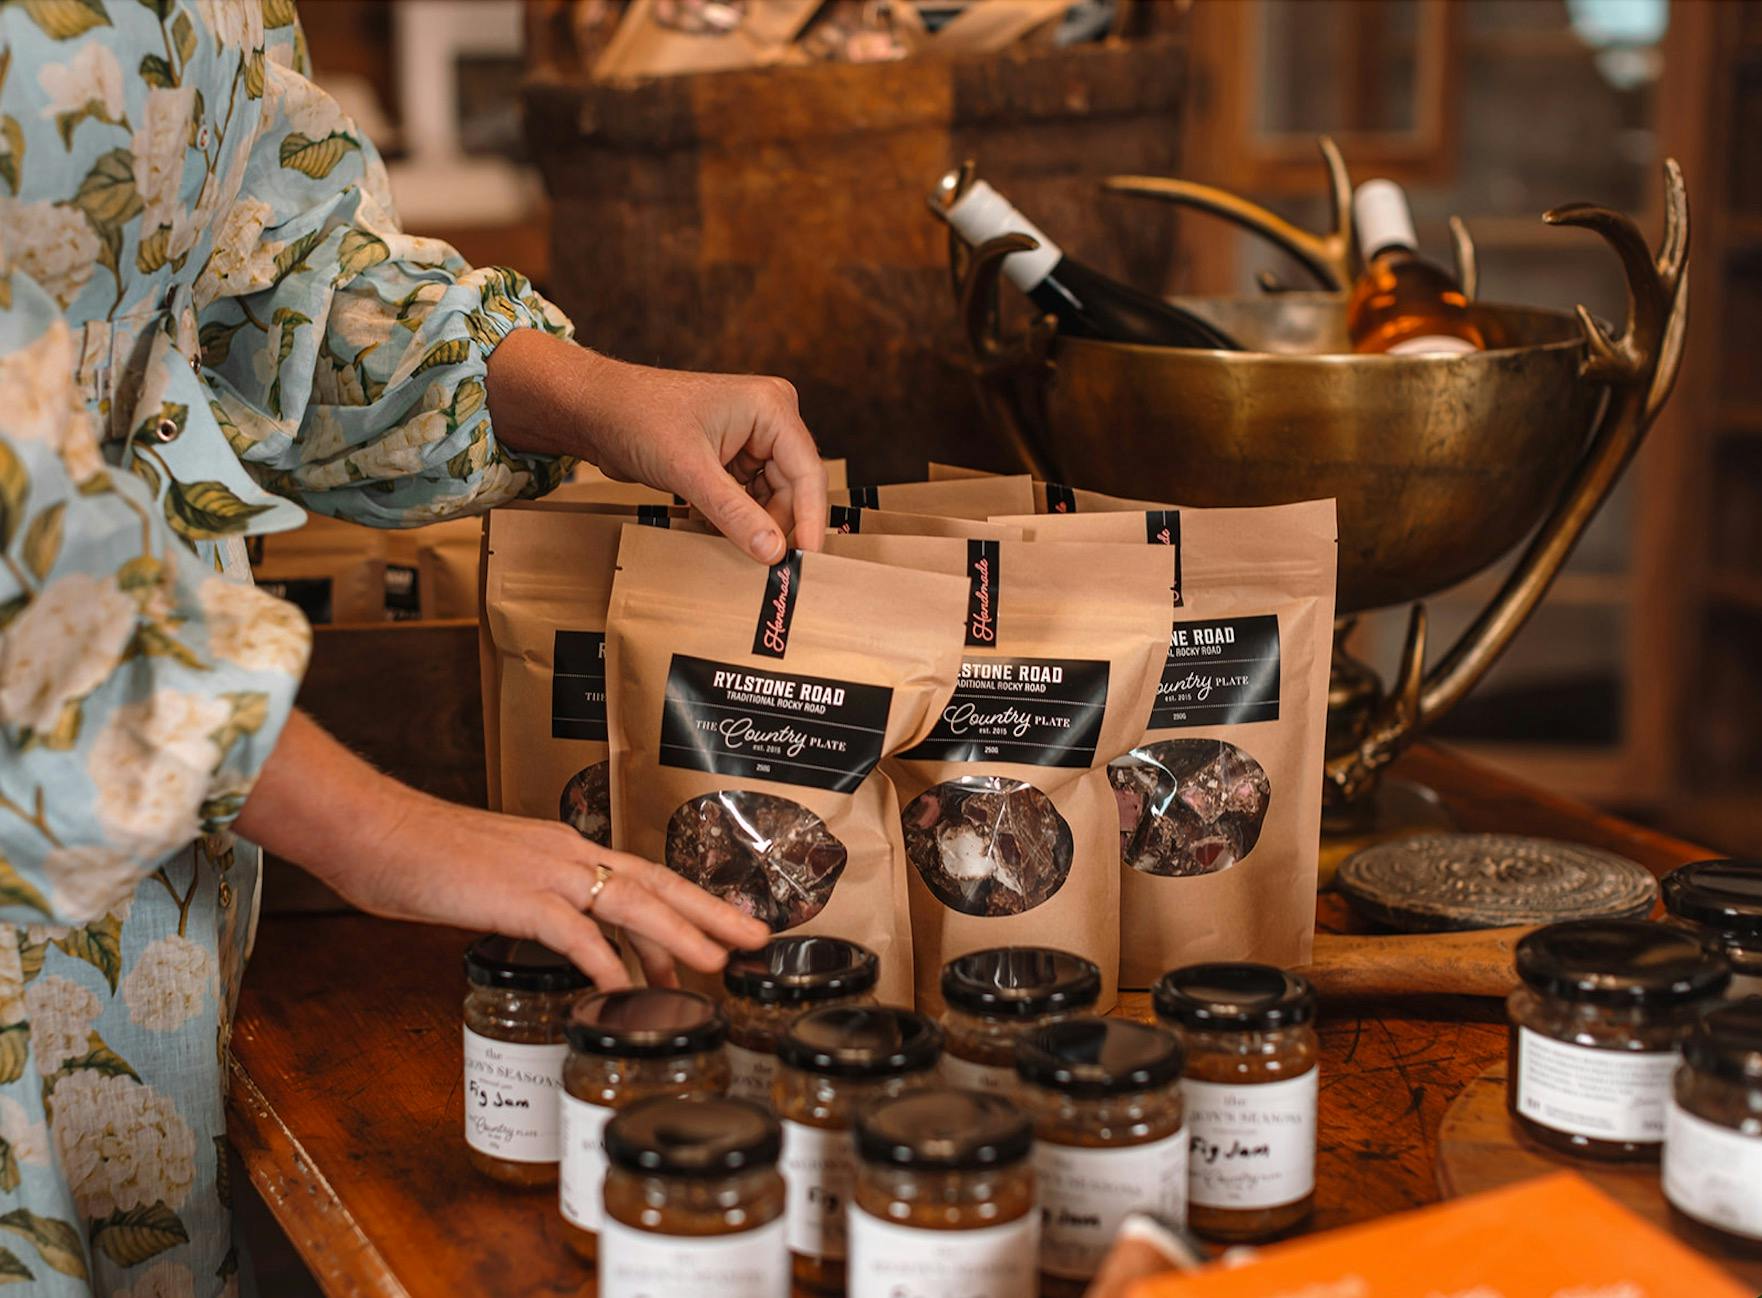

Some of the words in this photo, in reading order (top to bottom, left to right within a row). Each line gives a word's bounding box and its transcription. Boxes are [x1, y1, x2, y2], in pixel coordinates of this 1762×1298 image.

[763, 566, 791, 652] Handmade
[972, 557, 990, 642] Handmade
[1193, 626, 1235, 646] ROAD
[1176, 646, 1200, 657] ROCKY
[1201, 645, 1222, 656] ROAD
[713, 670, 797, 699] RYLSTONE
[800, 683, 846, 706] ROAD
[997, 682, 1022, 692] ROCKY
[1024, 683, 1047, 693] ROAD
[1019, 665, 1063, 684] ROAD
[1216, 675, 1249, 687] PLATE
[726, 690, 776, 707] TRADITIONAL
[777, 698, 803, 711] ROCKY
[804, 702, 826, 715] ROAD
[943, 703, 1031, 738] Country
[1035, 715, 1071, 728] PLATE
[992, 727, 1008, 735] 2015
[696, 719, 718, 731] THE
[719, 717, 808, 757] Country
[809, 737, 847, 752] PLATE
[470, 1080, 488, 1107] Fig
[494, 1093, 530, 1109] Jam
[1190, 1135, 1218, 1164] Fig
